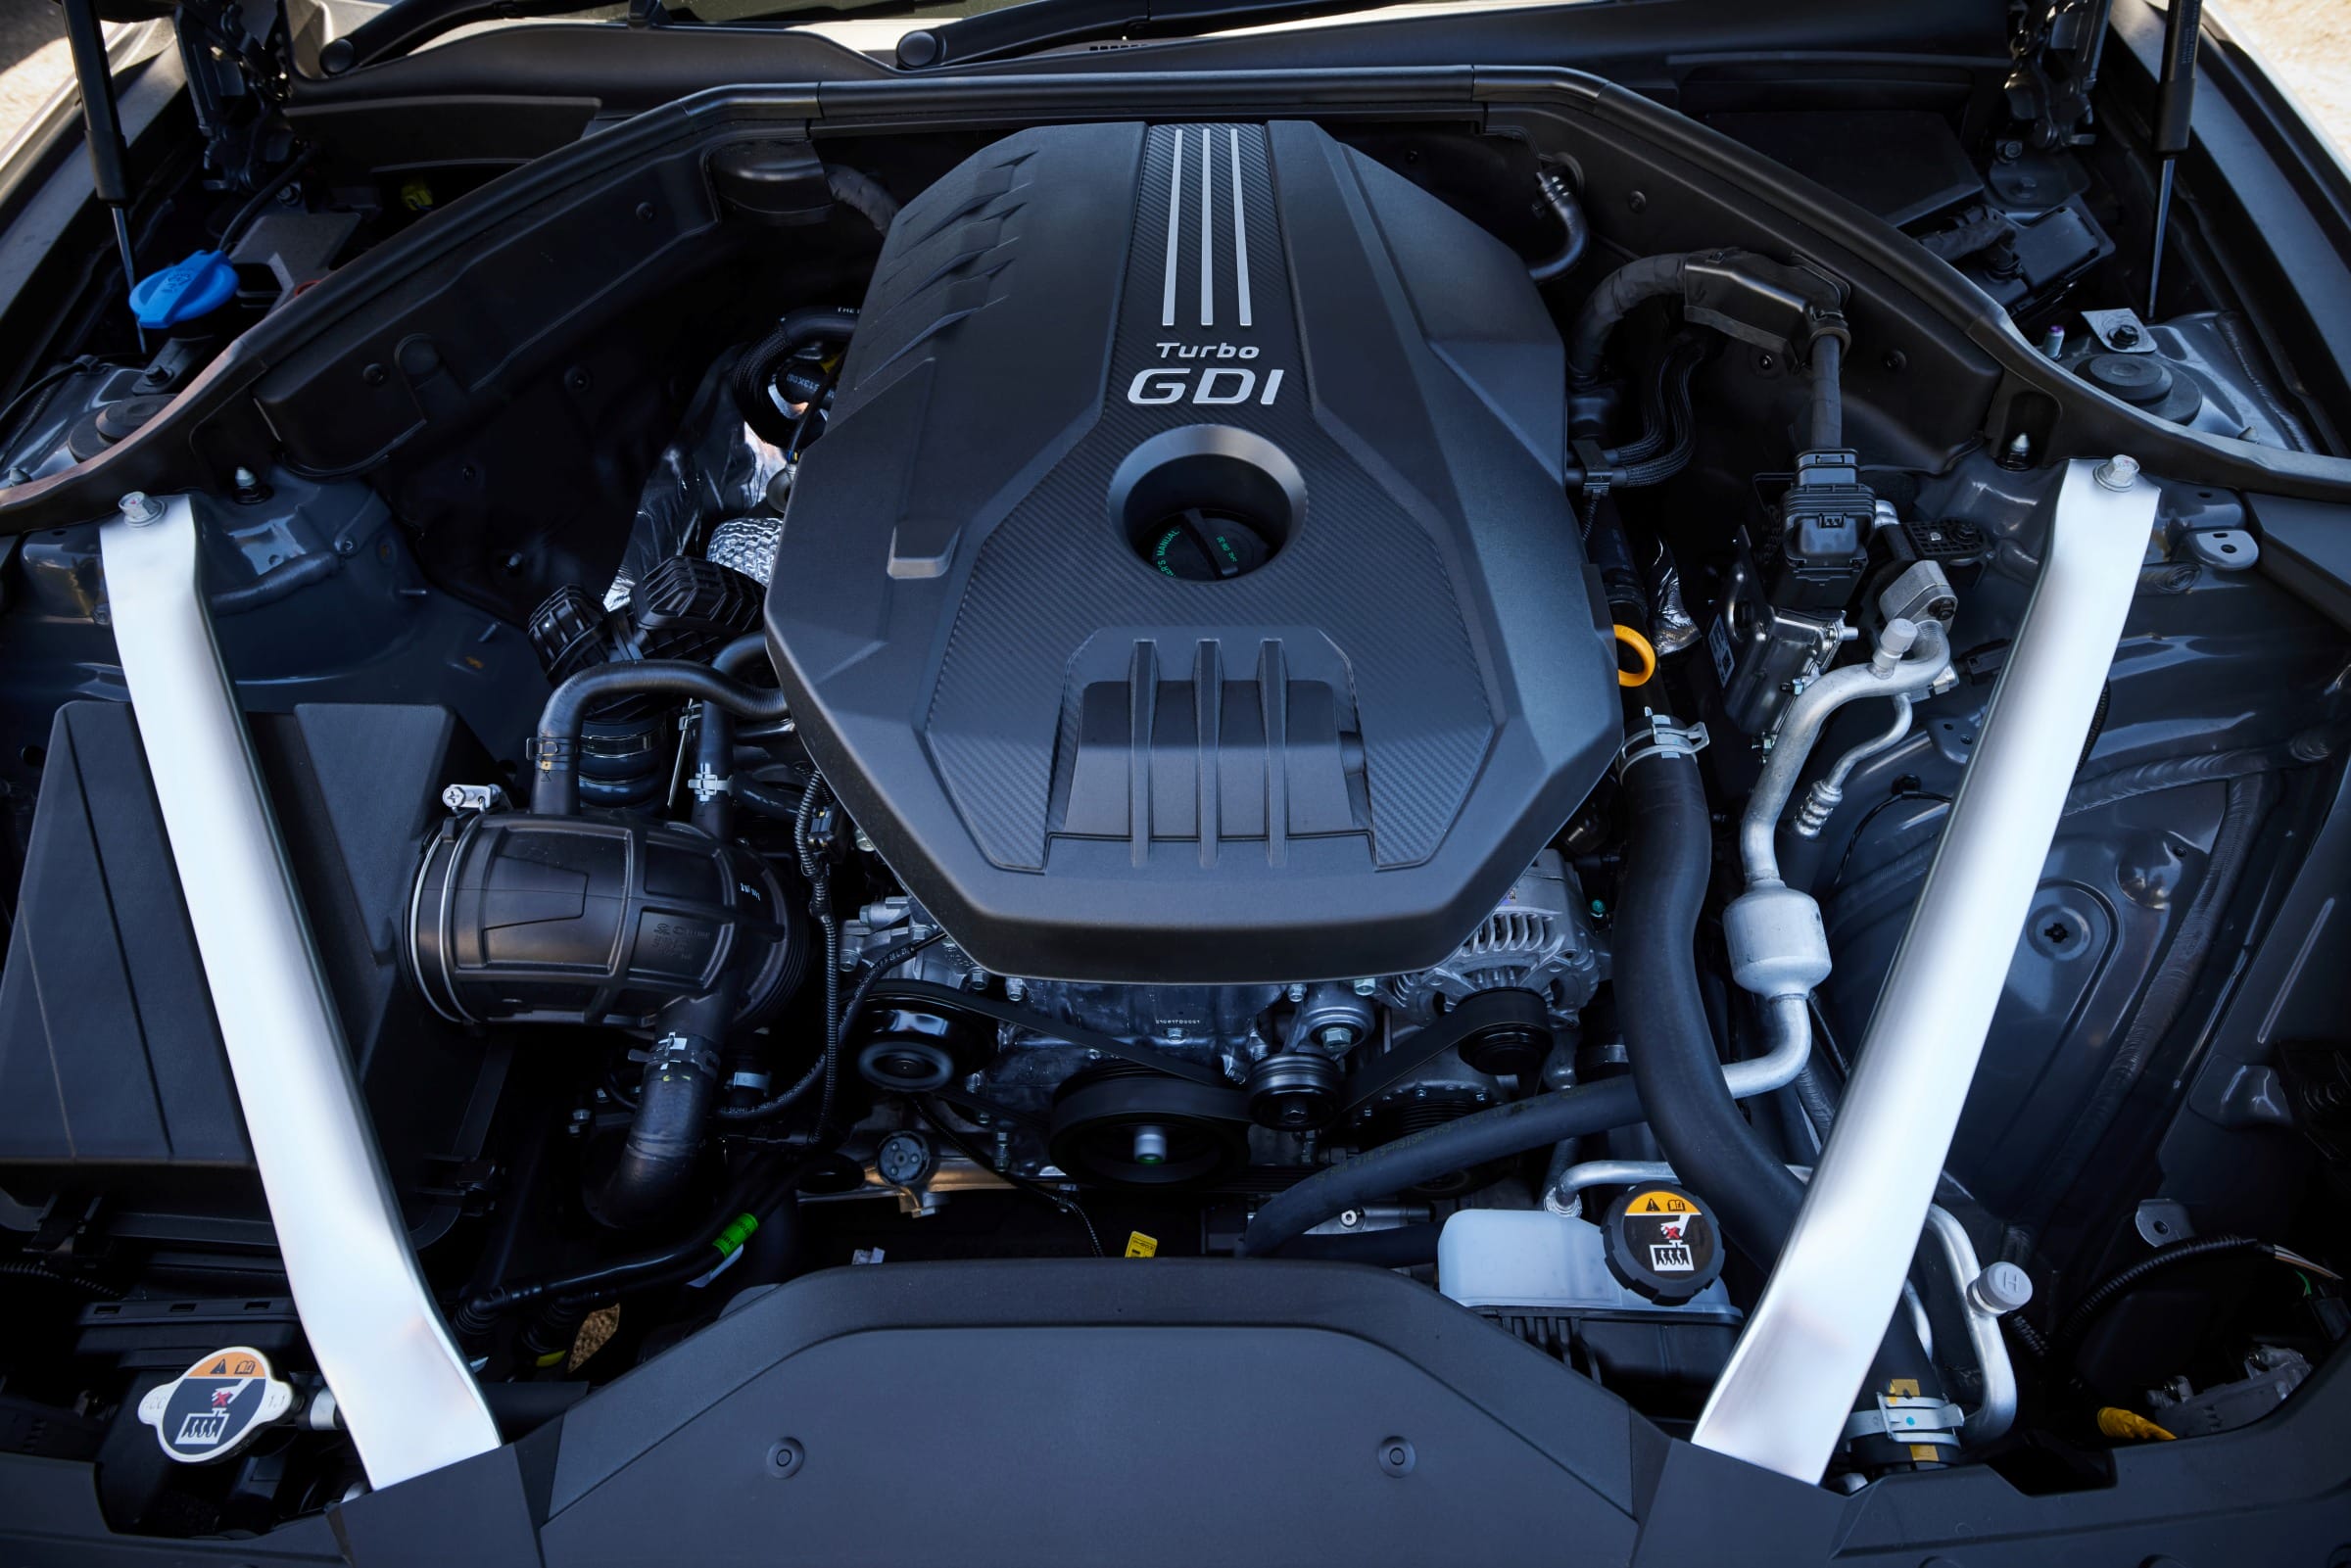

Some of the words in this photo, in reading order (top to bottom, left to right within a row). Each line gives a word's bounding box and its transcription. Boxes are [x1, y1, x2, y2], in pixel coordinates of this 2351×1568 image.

[1156, 343, 1260, 358] Turbo
[1128, 368, 1284, 404] GDI
[1156, 526, 1181, 556] MANUAL
[1157, 559, 1176, 577] ER'S
